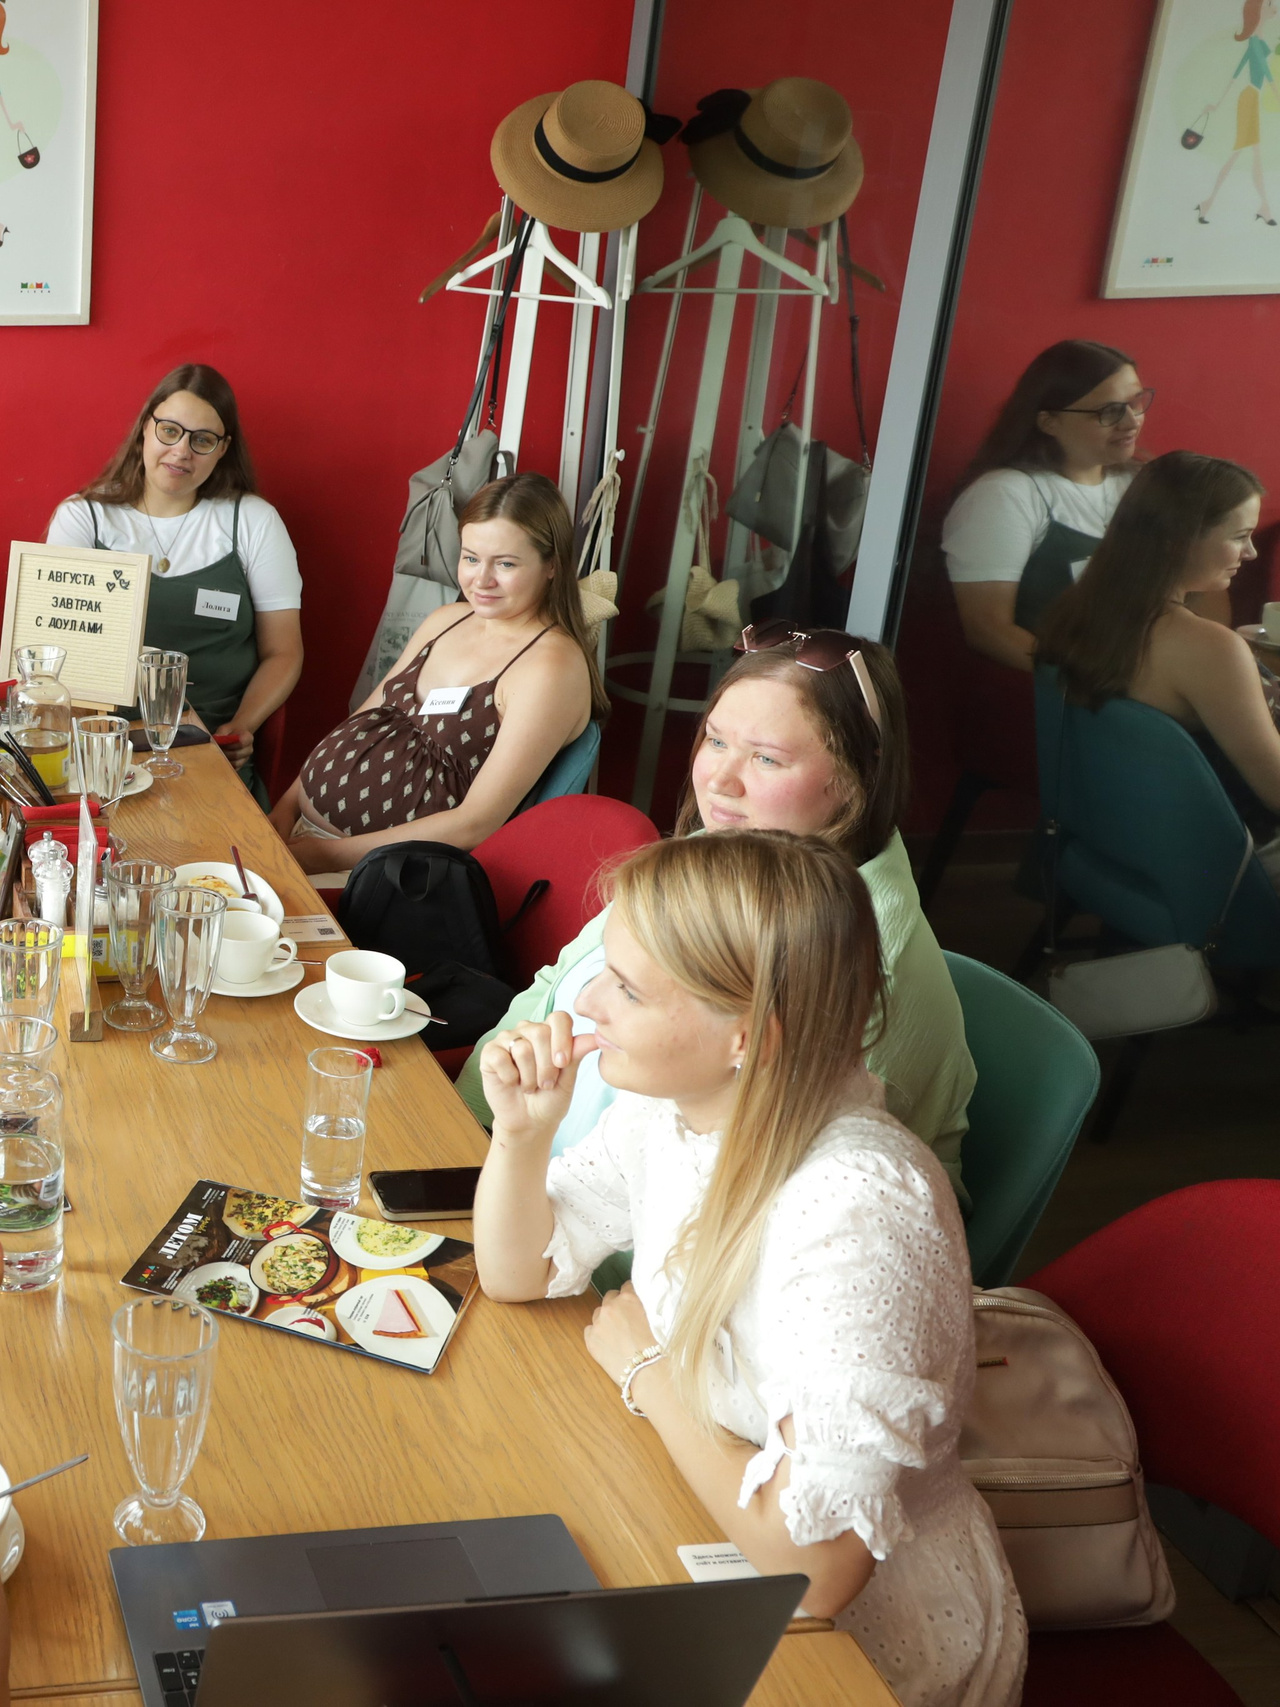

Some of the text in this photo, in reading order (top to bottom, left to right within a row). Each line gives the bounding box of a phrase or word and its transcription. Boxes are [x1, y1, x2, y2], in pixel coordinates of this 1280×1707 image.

[37, 568, 96, 587] 1 АВГУСТА
[51, 596, 102, 613] ЗАВТРАК
[202, 601, 231, 613] Лолита
[35, 616, 103, 634] С ДОУЛАМИ
[158, 1212, 203, 1260] ЛЕТОМ
